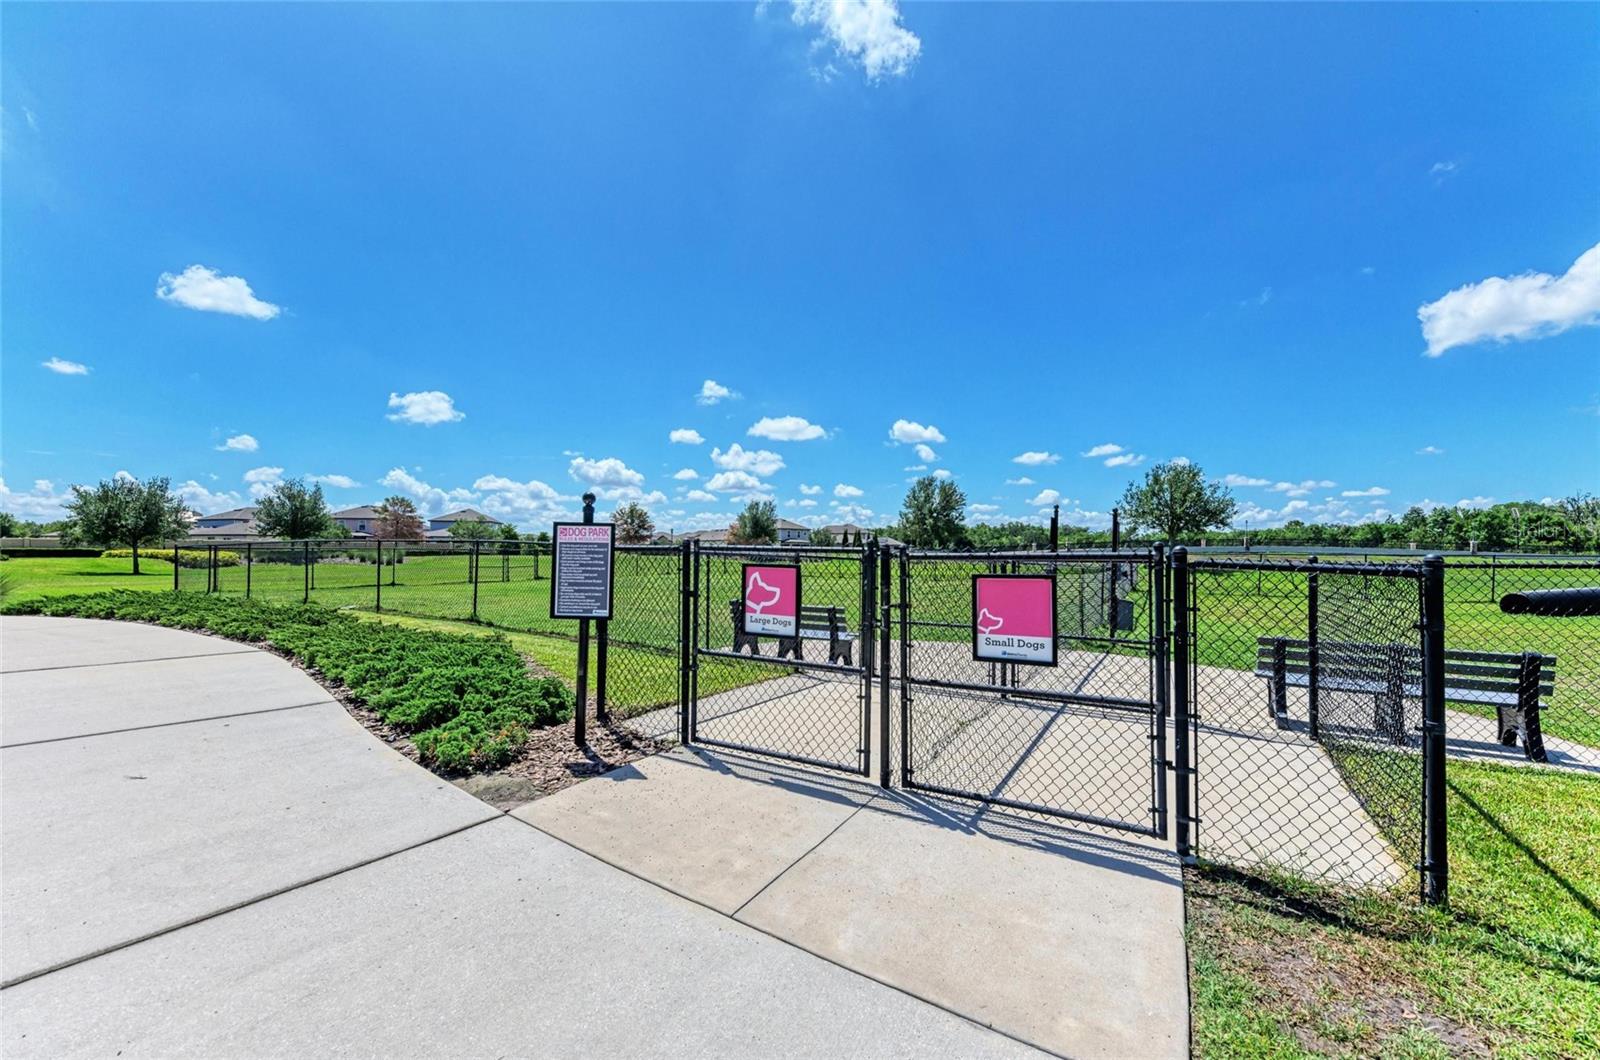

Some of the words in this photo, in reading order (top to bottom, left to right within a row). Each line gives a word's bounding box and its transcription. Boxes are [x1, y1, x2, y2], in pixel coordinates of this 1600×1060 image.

[568, 527, 587, 536] DOG
[588, 527, 609, 536] PARK
[750, 615, 771, 625] Large
[772, 617, 792, 627] Dogs
[984, 637, 1015, 648] Small
[1017, 639, 1045, 651] Dogs
